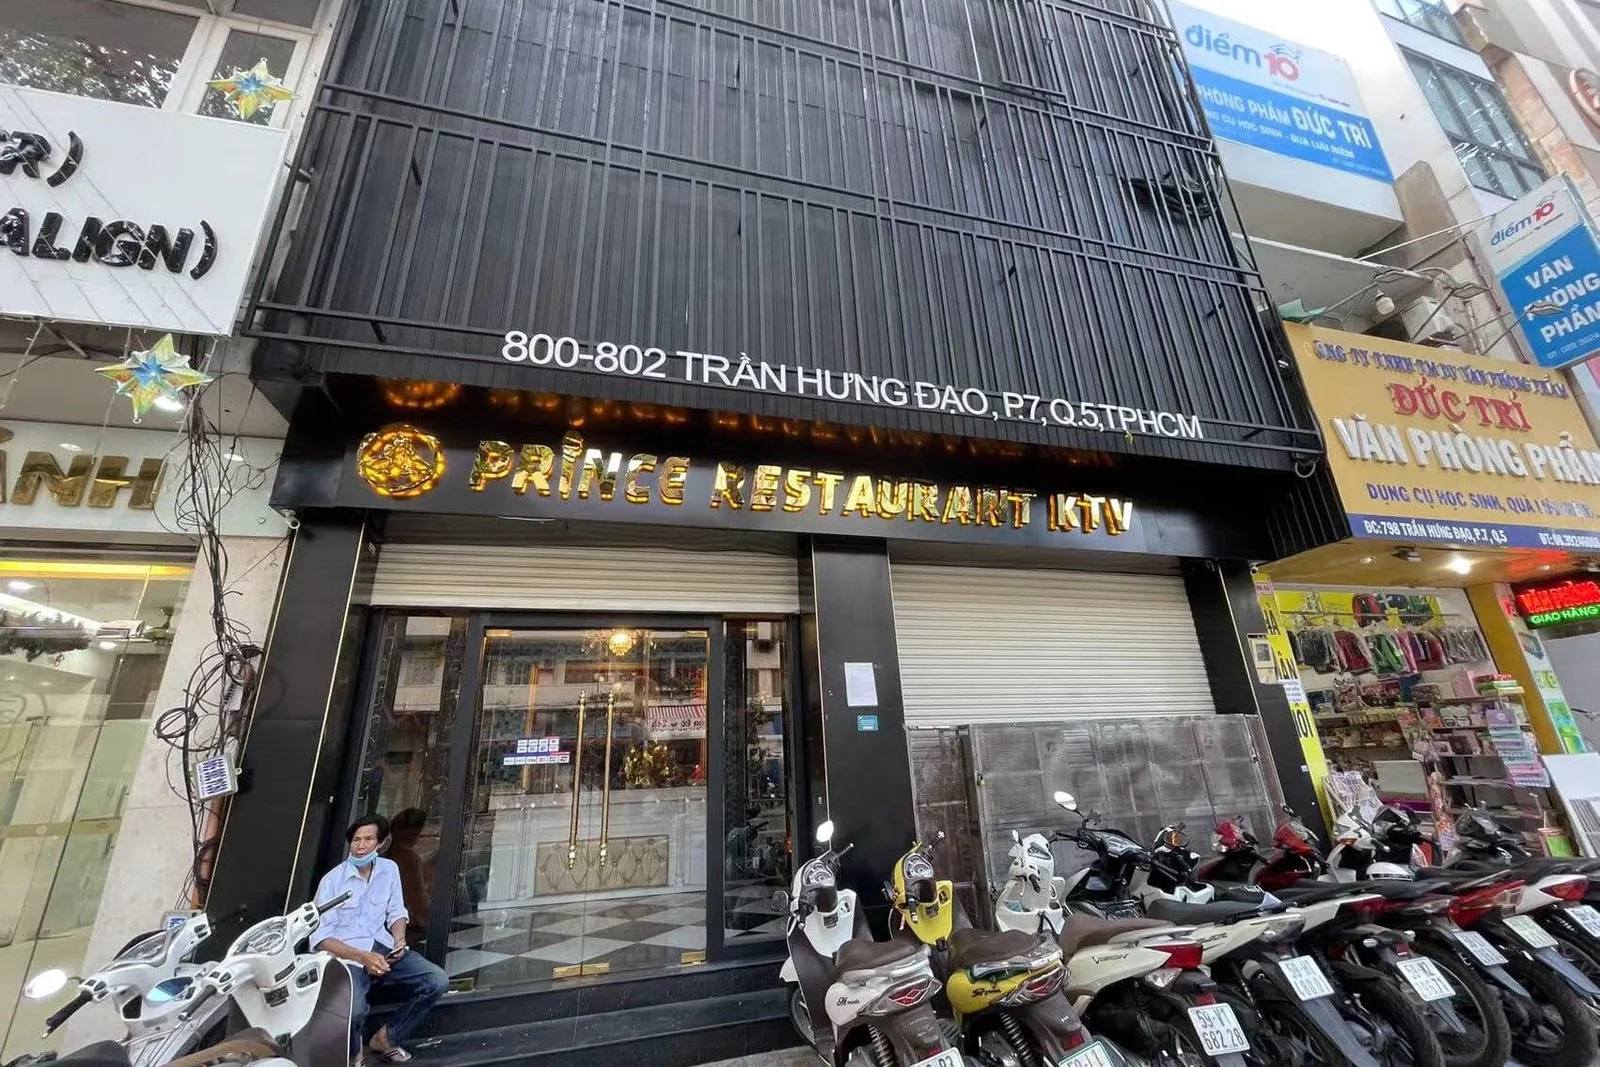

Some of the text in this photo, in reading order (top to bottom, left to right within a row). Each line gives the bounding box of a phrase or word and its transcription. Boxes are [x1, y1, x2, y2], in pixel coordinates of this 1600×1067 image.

[1525, 254, 1574, 290] VĂN
[501, 330, 667, 379] 800-802
[675, 351, 789, 394] TRẦN
[796, 364, 909, 406] HƯNG
[1386, 374, 1533, 432] ĐỨC TRÍ
[1331, 413, 1410, 465] VĂN
[1405, 422, 1529, 479] PHÒNG
[708, 460, 1038, 528] RESTAURANT
[1047, 492, 1134, 536] KTV
[1366, 482, 1411, 506] DỤNG
[1413, 487, 1435, 509] CỤ
[1435, 489, 1468, 511] HỌC
[1530, 604, 1599, 624] GIAO HÀNG
